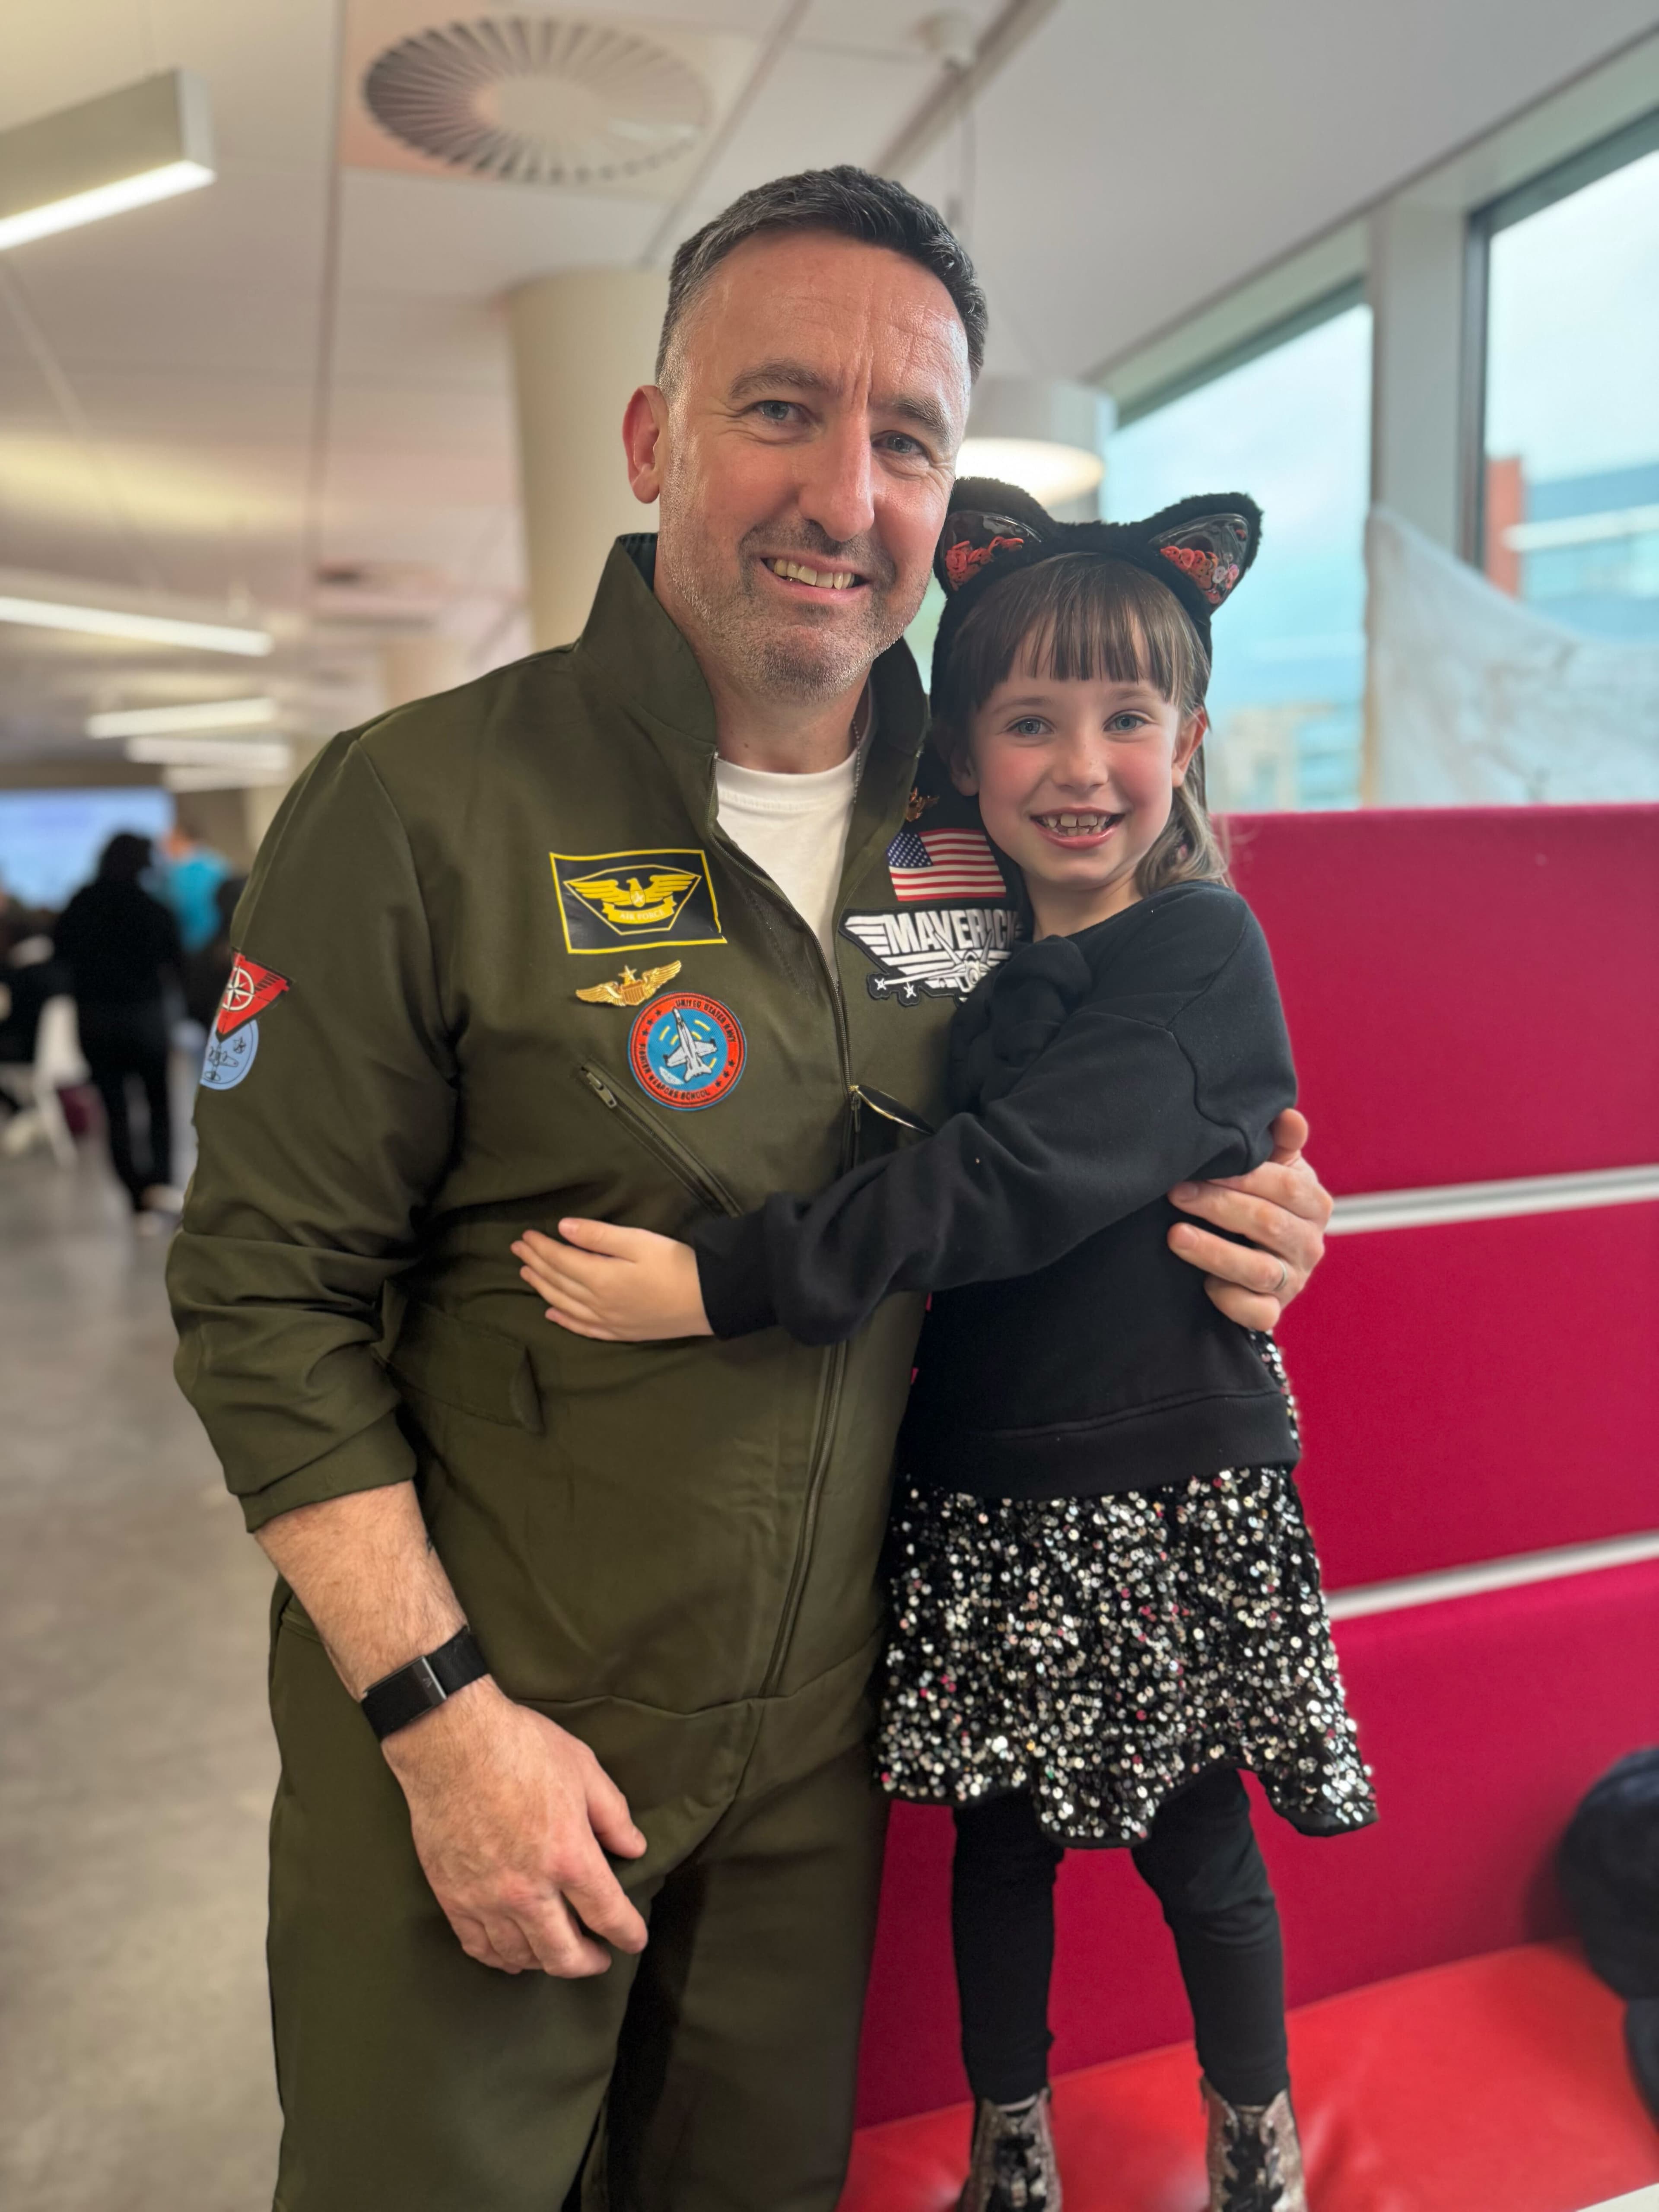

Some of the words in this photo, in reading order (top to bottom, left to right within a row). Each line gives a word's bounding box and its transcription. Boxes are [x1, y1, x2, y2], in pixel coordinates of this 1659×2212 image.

[637, 909, 664, 920] FORCE
[883, 909, 1020, 953] MAVERICK
[676, 999, 701, 1008] UNITED
[704, 1003, 726, 1024] STATES
[724, 1023, 736, 1042] NAVY
[649, 1074, 678, 1099] WEAPONS
[680, 1090, 711, 1100] SCHOOL
